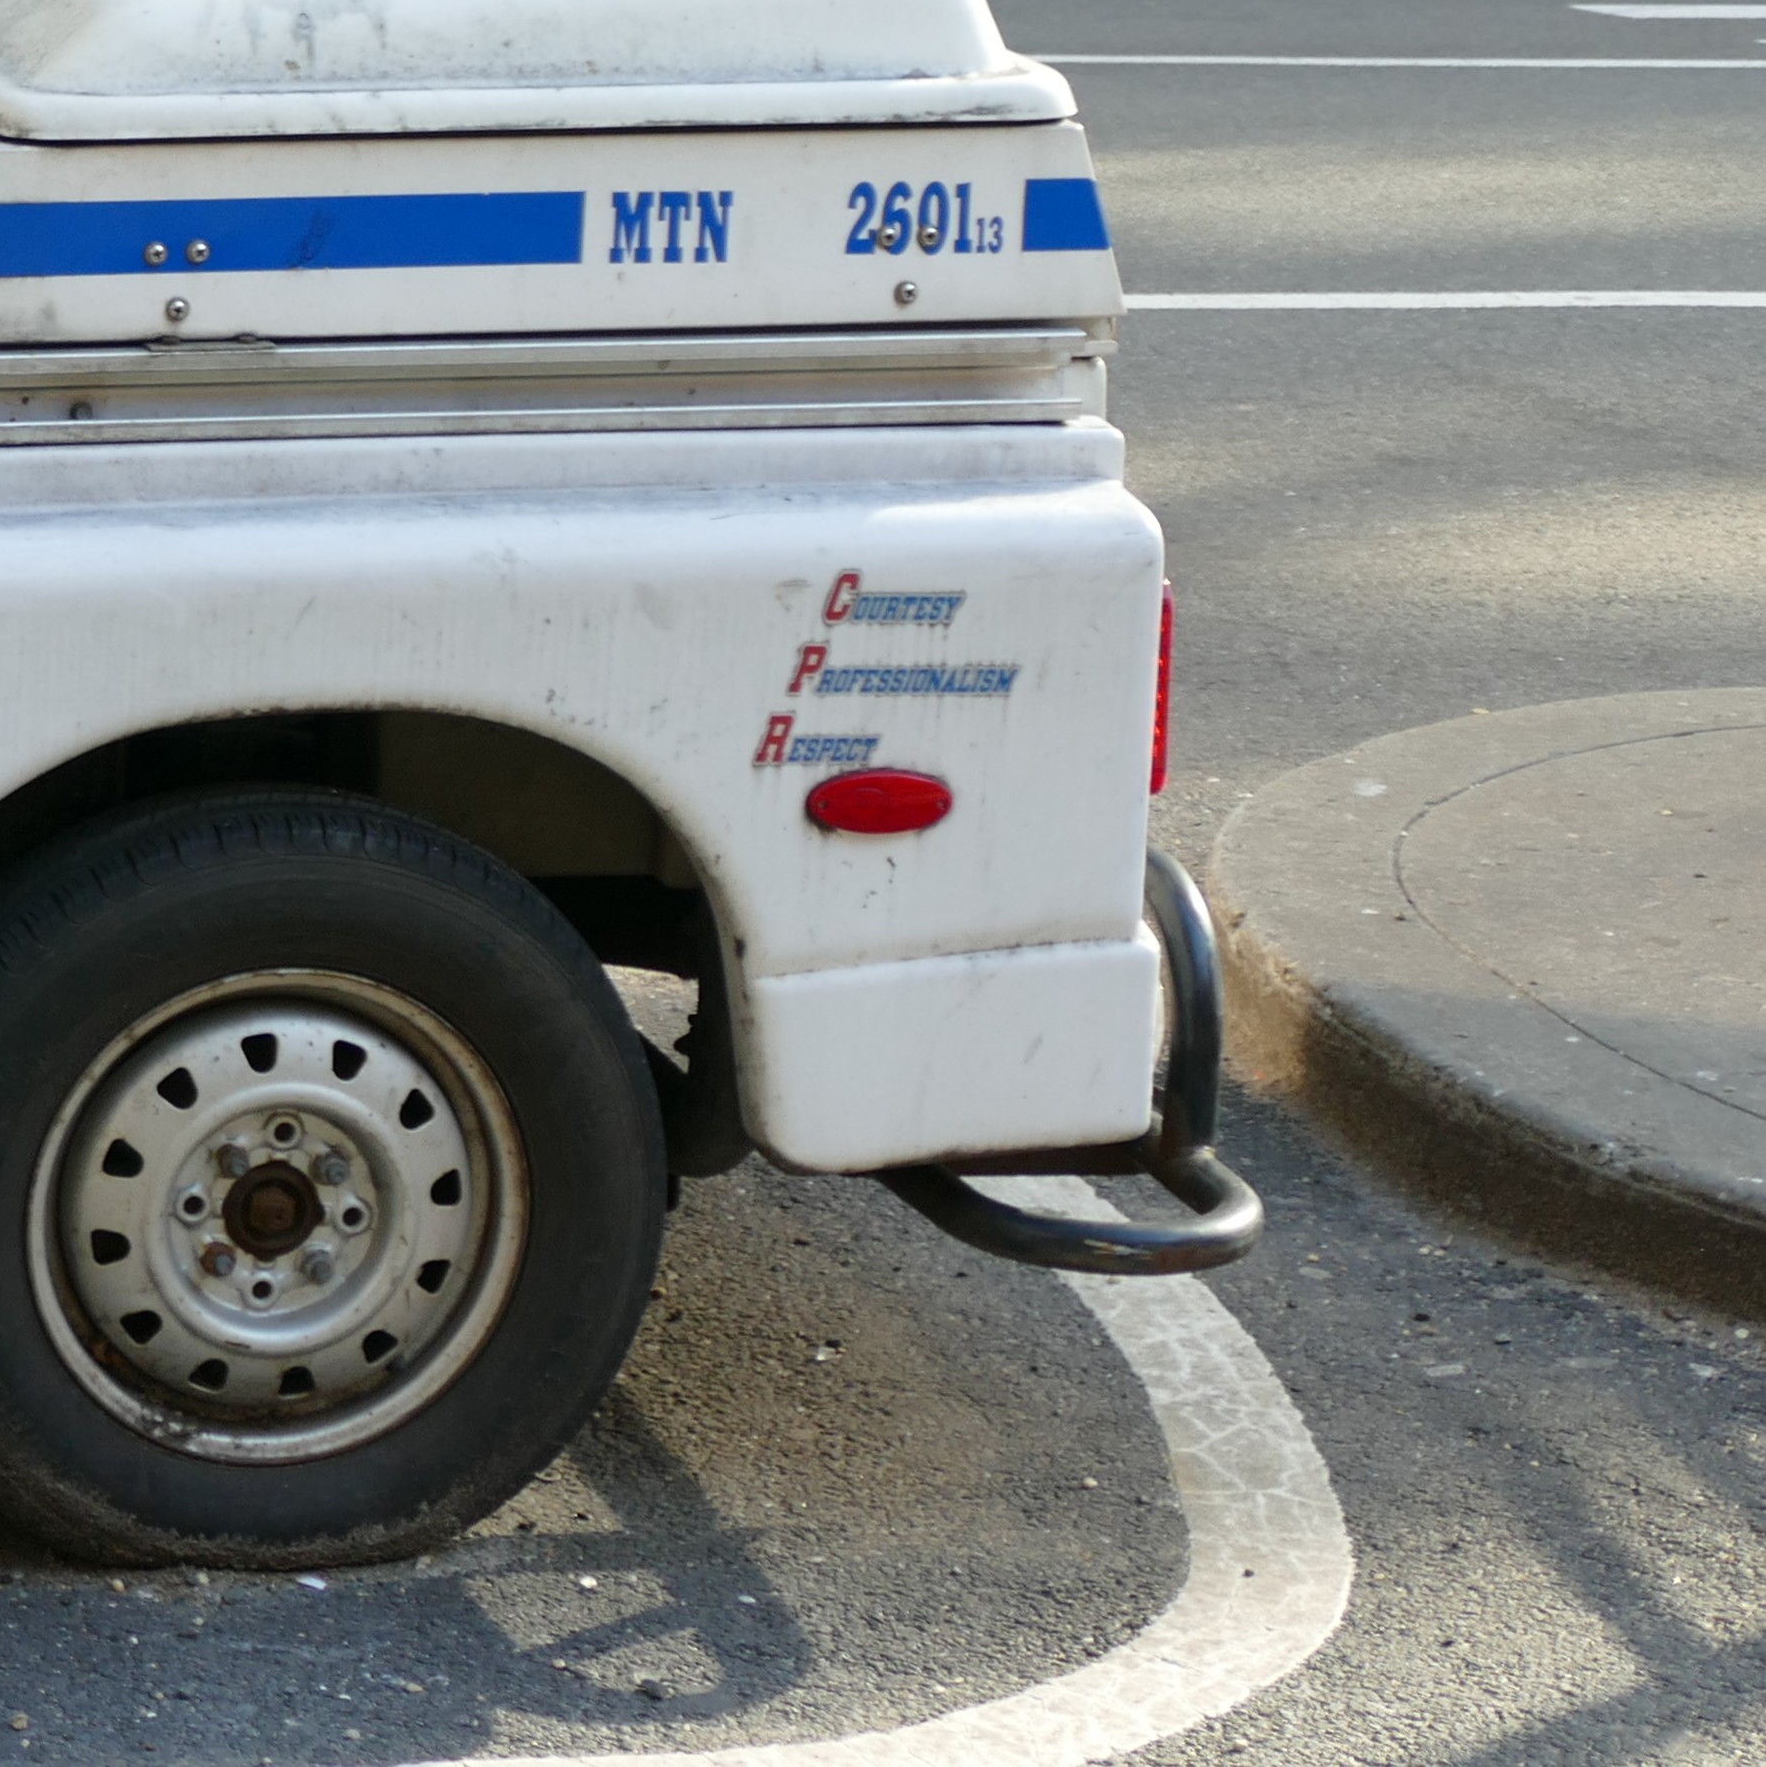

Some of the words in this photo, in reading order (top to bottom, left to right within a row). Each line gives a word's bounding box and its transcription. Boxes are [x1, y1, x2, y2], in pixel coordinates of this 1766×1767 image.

[609, 190, 734, 264] MTN
[788, 644, 1020, 694] PROFESSIONALISM
[754, 714, 880, 764] RESPECT
